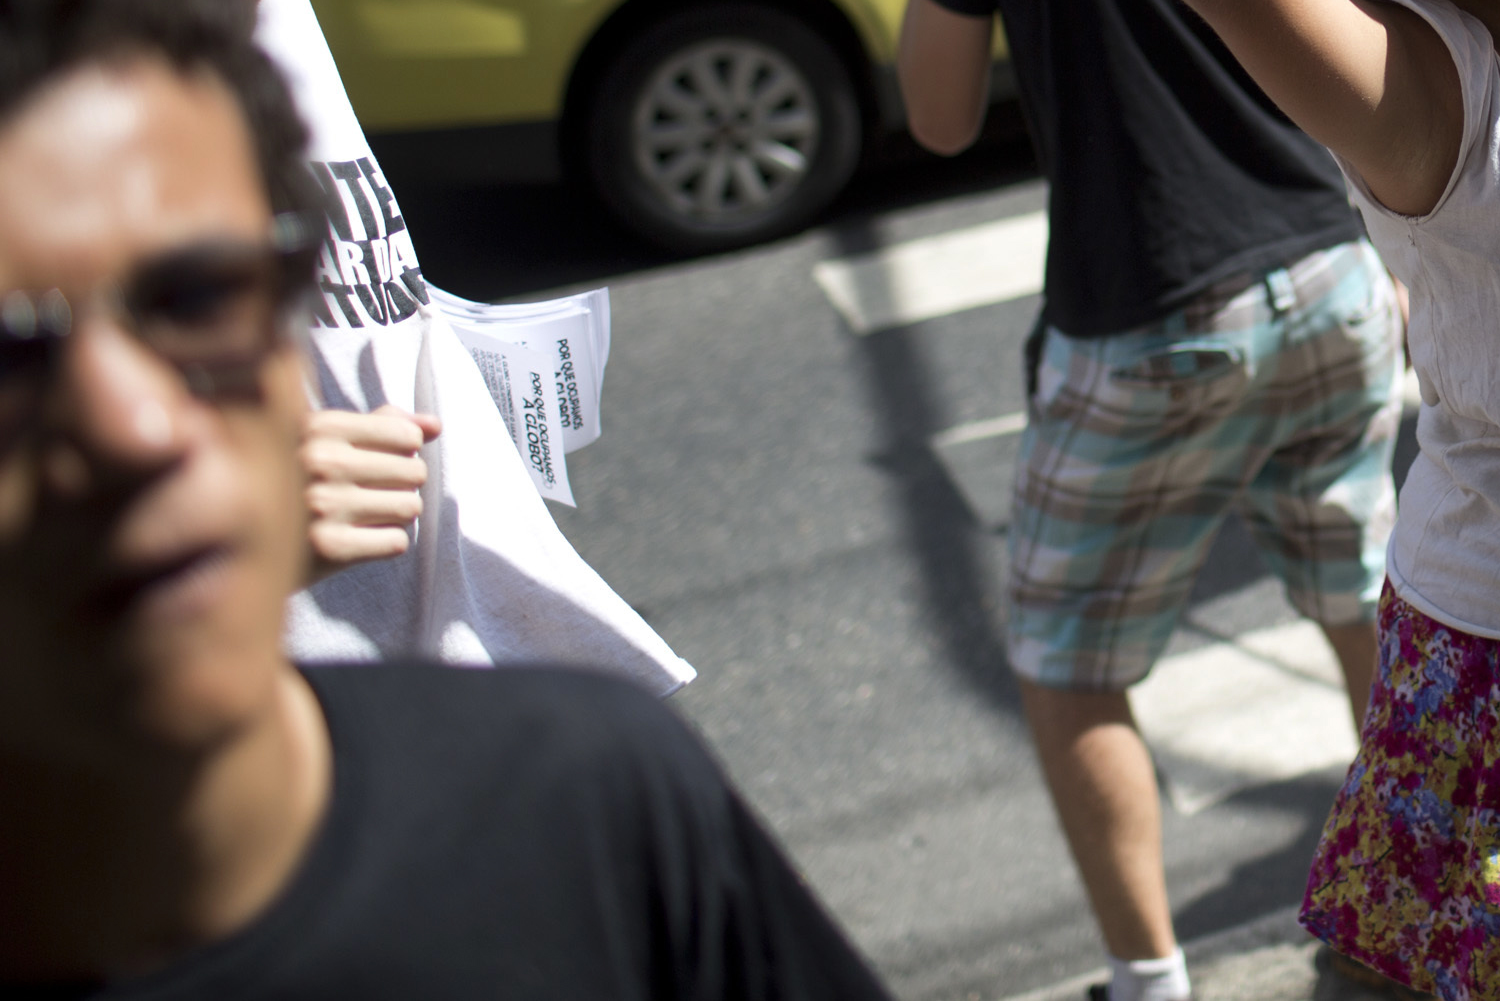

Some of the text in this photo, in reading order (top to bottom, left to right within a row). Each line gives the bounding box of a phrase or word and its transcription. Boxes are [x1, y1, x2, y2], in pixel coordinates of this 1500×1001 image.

[530, 371, 556, 485] POR QUE OCUPAMOS
[557, 338, 584, 430] POR QUE OCUPAMOS
[522, 397, 544, 474] A GLOBO?
